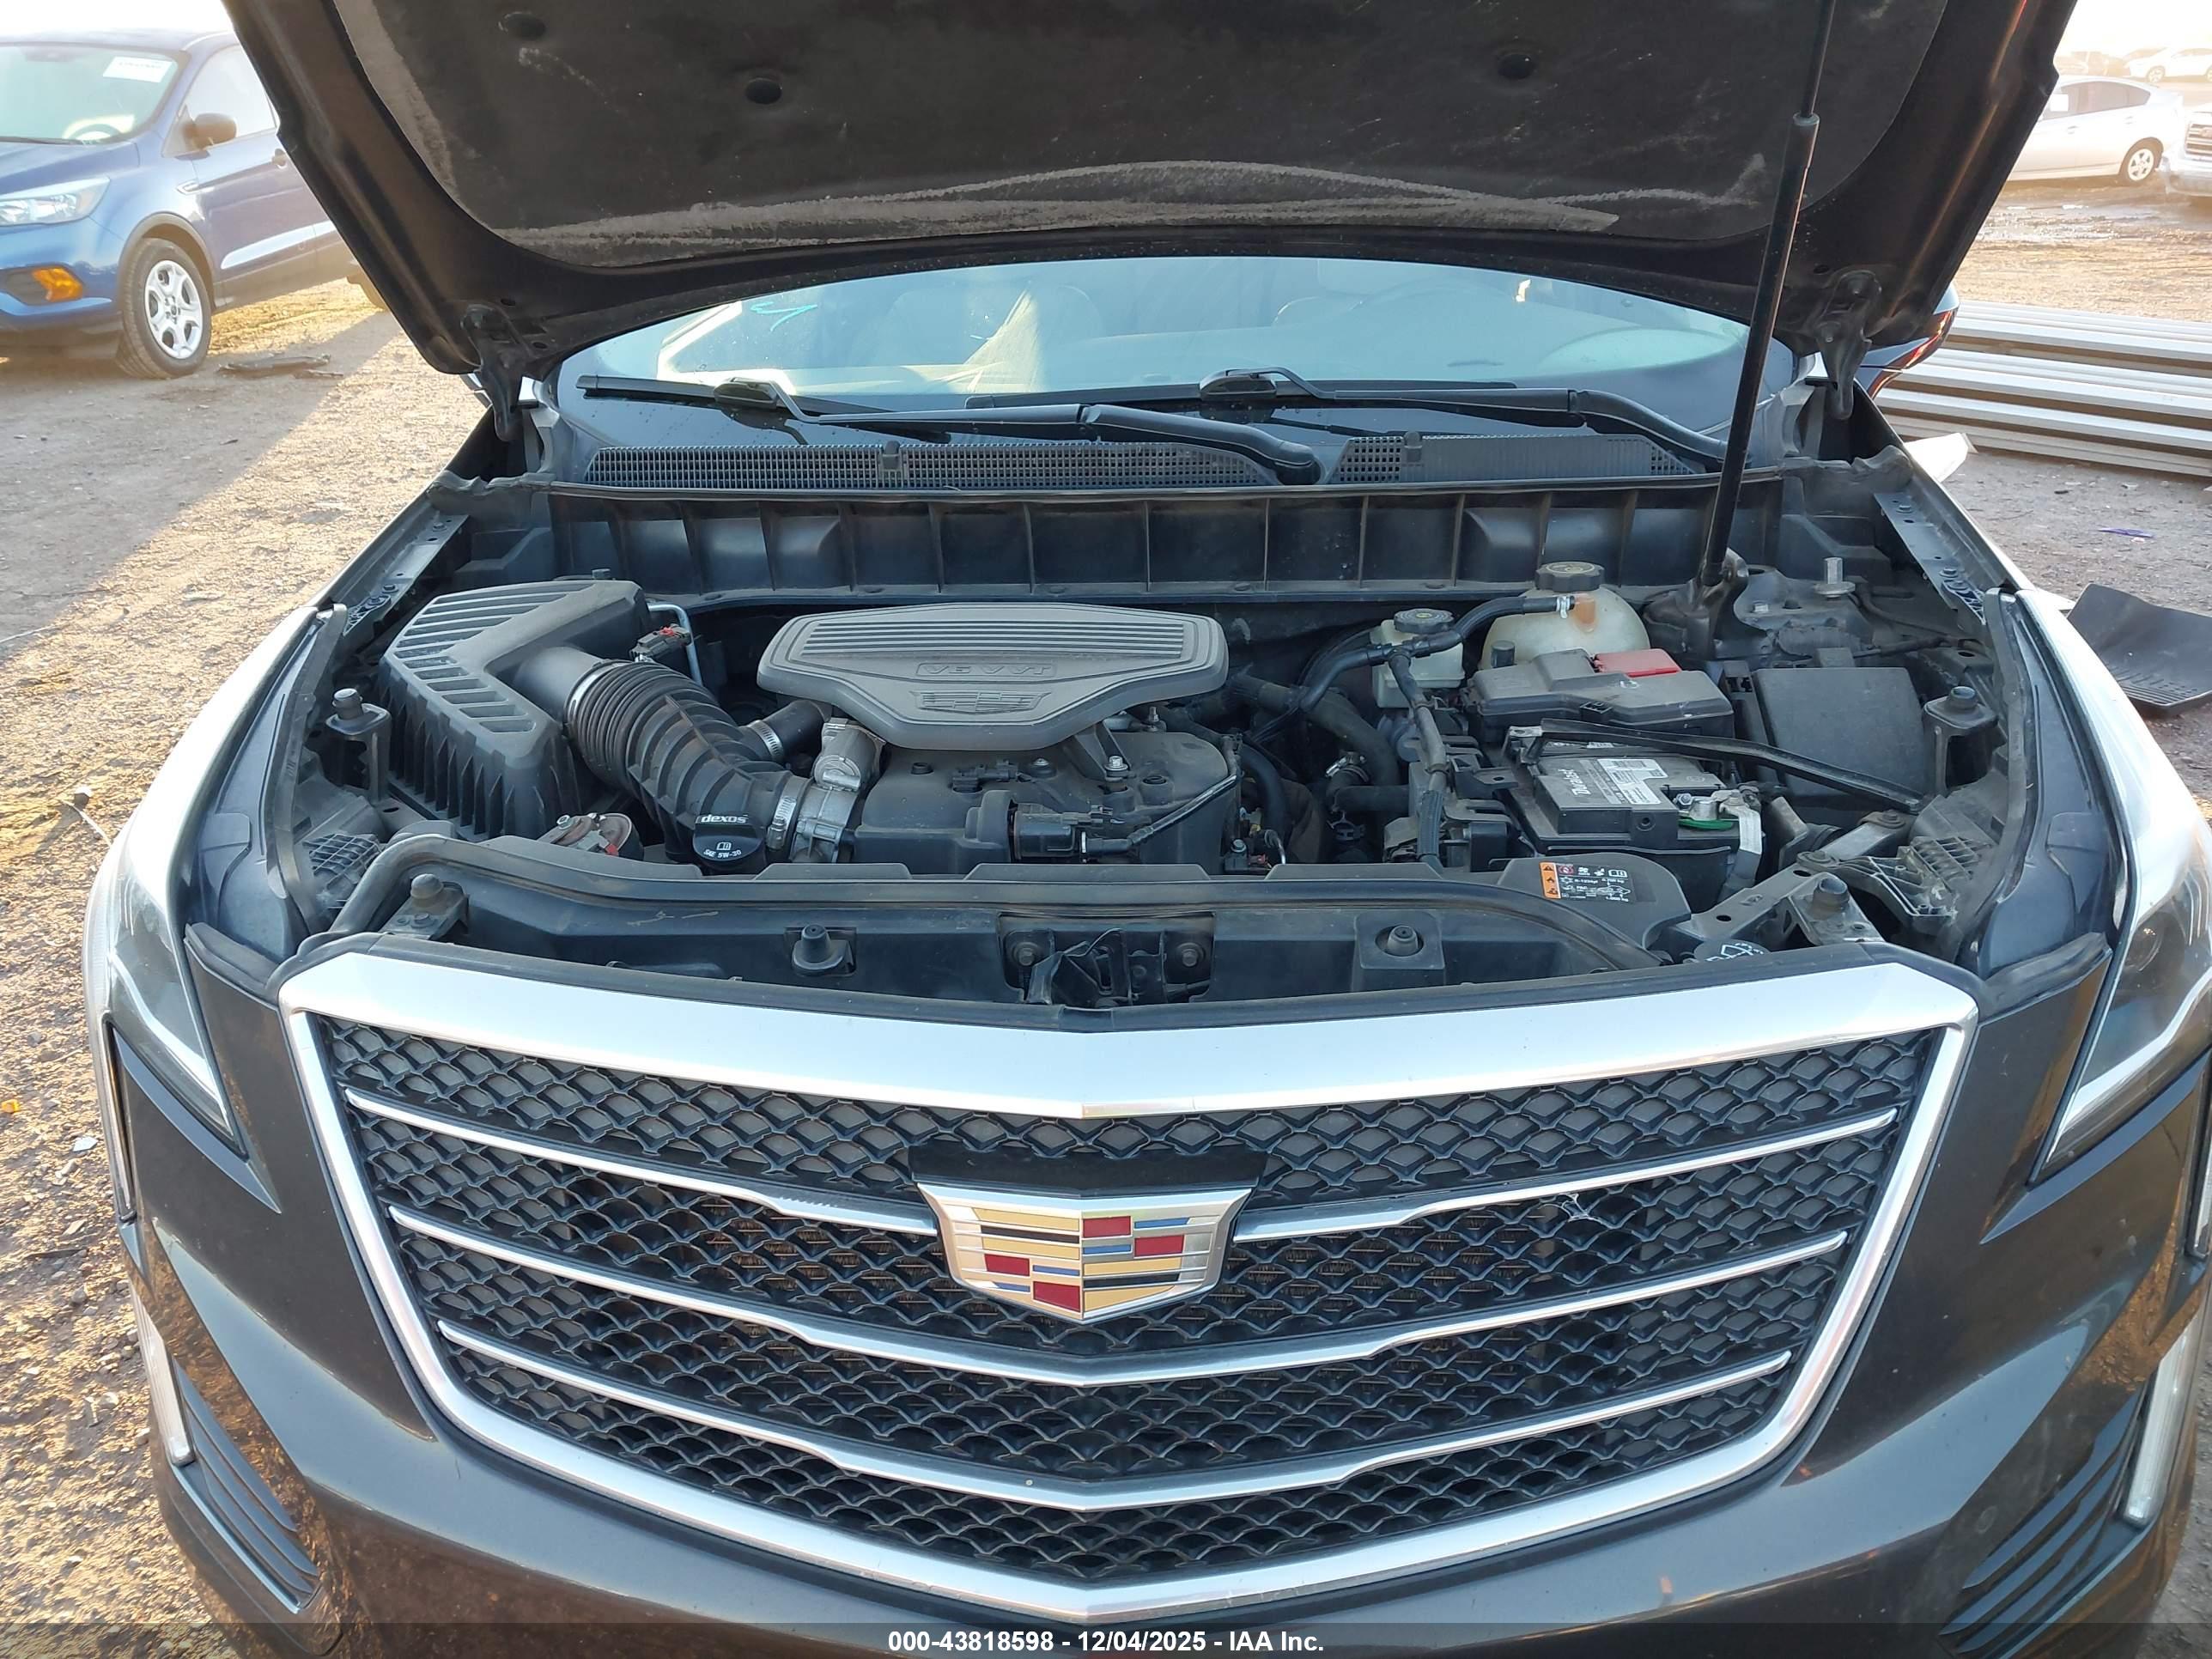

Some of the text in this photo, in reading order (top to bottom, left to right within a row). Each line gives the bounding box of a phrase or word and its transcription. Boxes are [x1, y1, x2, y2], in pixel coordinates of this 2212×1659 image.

[981, 665, 1051, 674] VVT
[1557, 769, 1592, 796] Duralast
[701, 814, 748, 823] dexos
[718, 850, 742, 859] 5W-30
